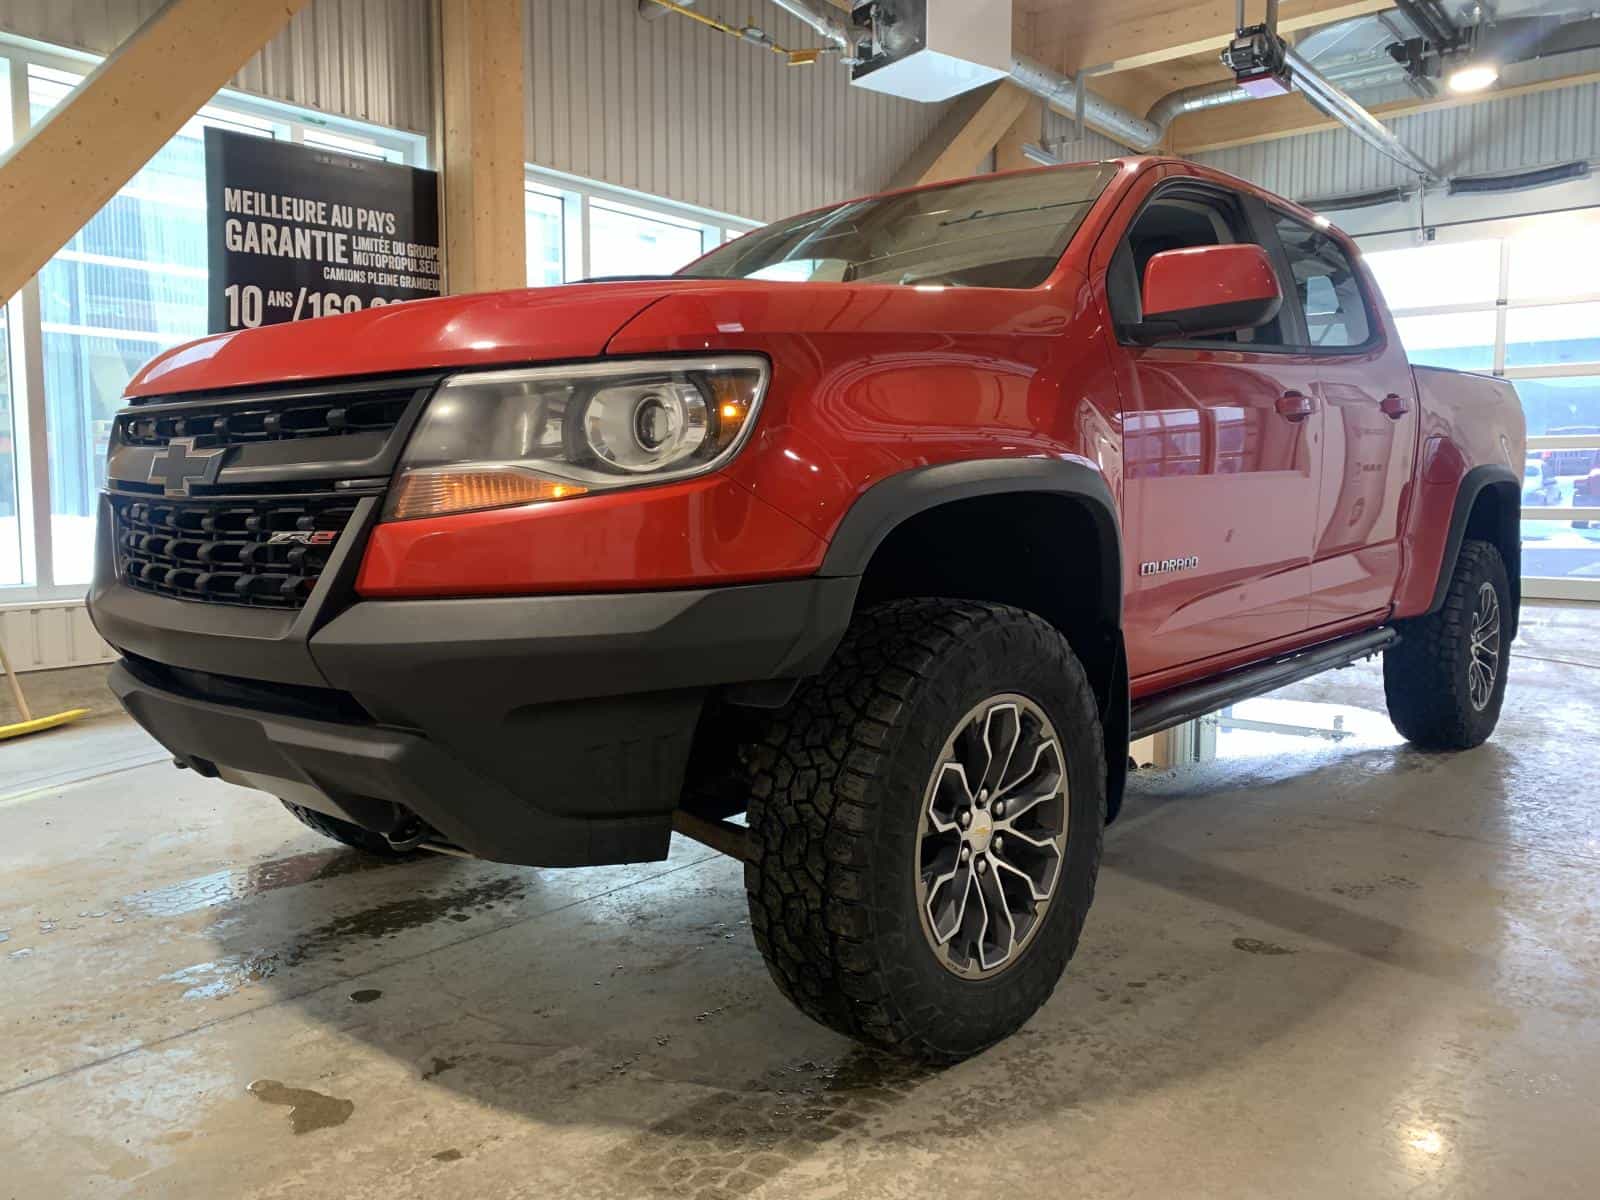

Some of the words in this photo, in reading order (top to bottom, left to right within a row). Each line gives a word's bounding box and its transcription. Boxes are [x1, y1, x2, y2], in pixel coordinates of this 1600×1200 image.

[224, 187, 327, 225] MEILLEURE
[331, 204, 353, 229] AU
[357, 207, 396, 235] PAYS
[225, 218, 349, 264] GARANTIE
[352, 235, 392, 255] LIMITÉE
[392, 240, 406, 256] DU
[323, 266, 367, 284] CAMIONS
[367, 271, 399, 287] PLEINE
[399, 275, 440, 291] GRANDEU
[224, 284, 263, 328] 10
[267, 530, 337, 545] ZR2
[1140, 556, 1199, 576] COLORADO
